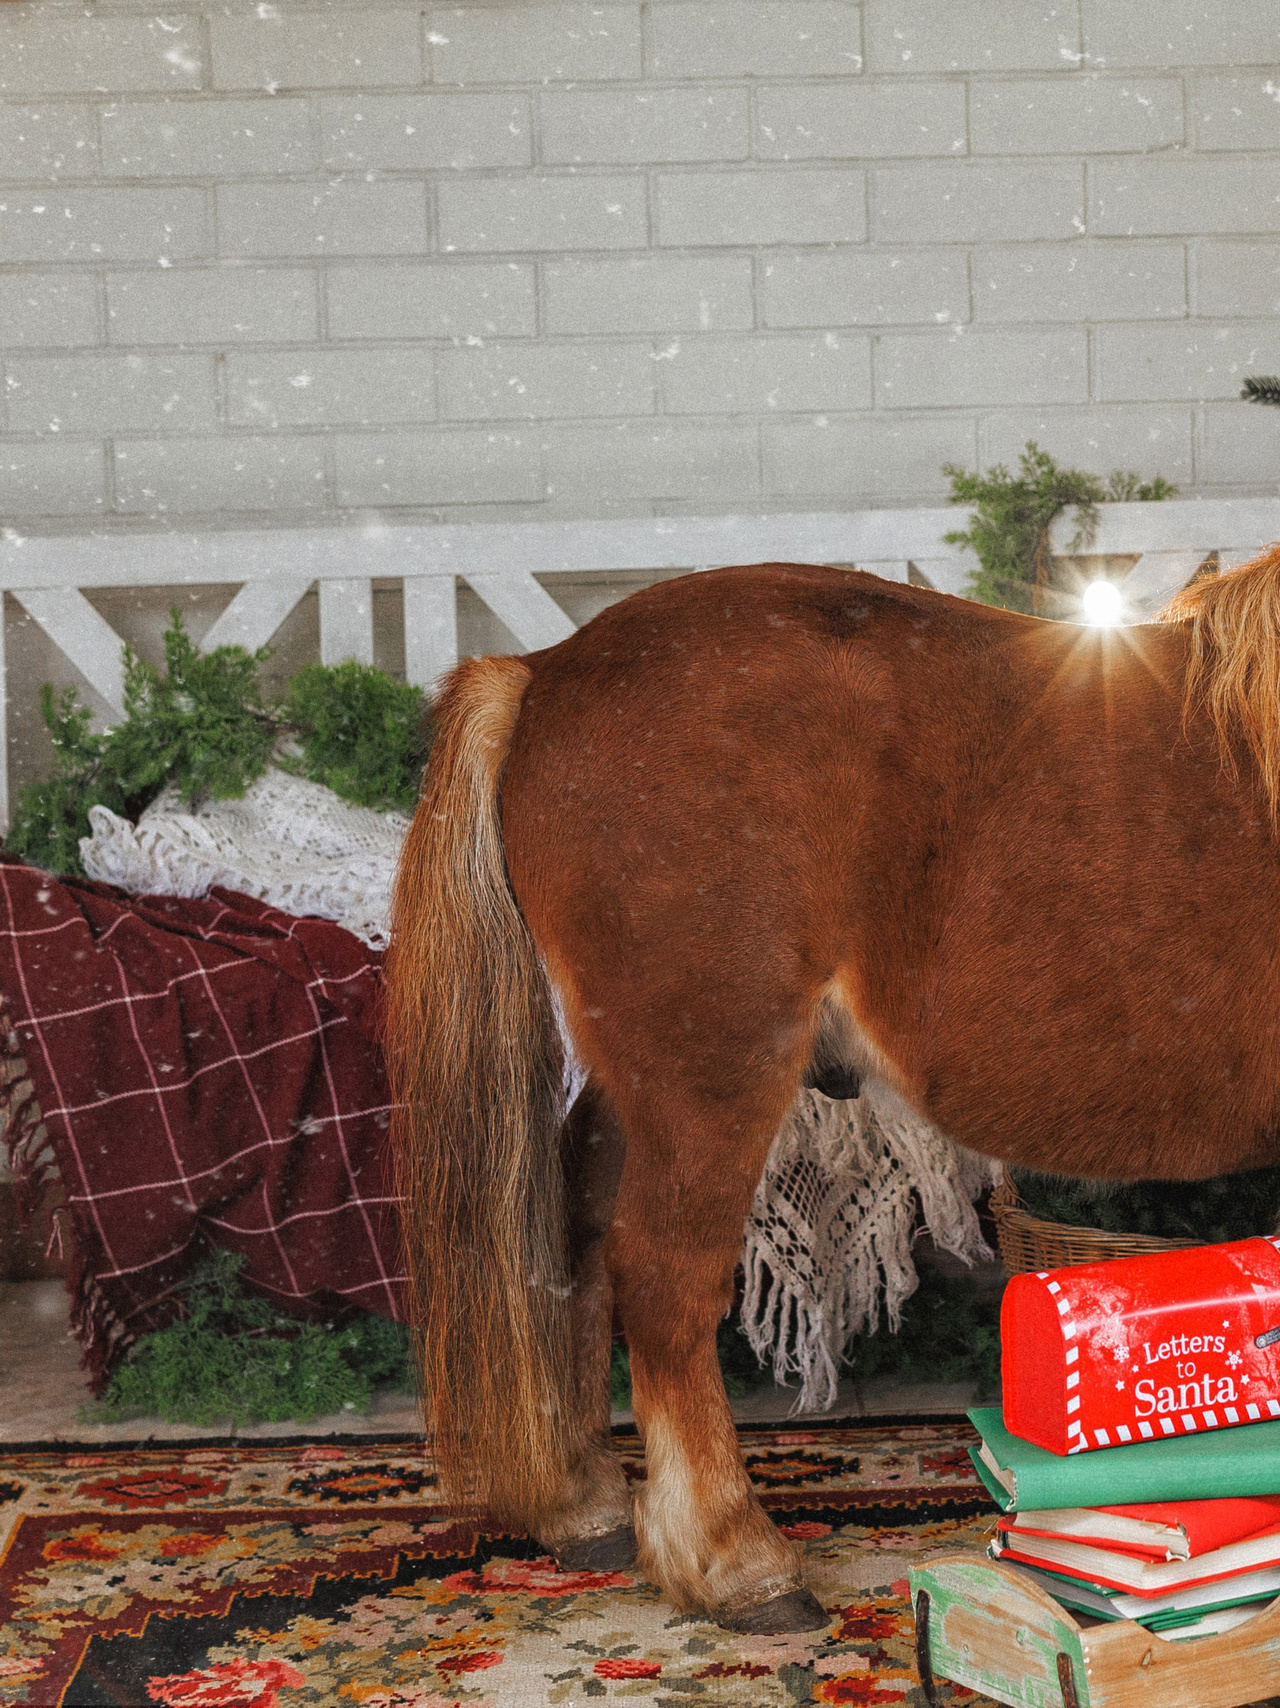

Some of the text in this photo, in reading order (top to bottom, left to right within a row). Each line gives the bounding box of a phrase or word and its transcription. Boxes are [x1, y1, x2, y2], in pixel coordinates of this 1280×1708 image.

[1143, 1333, 1226, 1365] Letters
[1176, 1361, 1197, 1378] to
[1134, 1373, 1239, 1417] Santa
